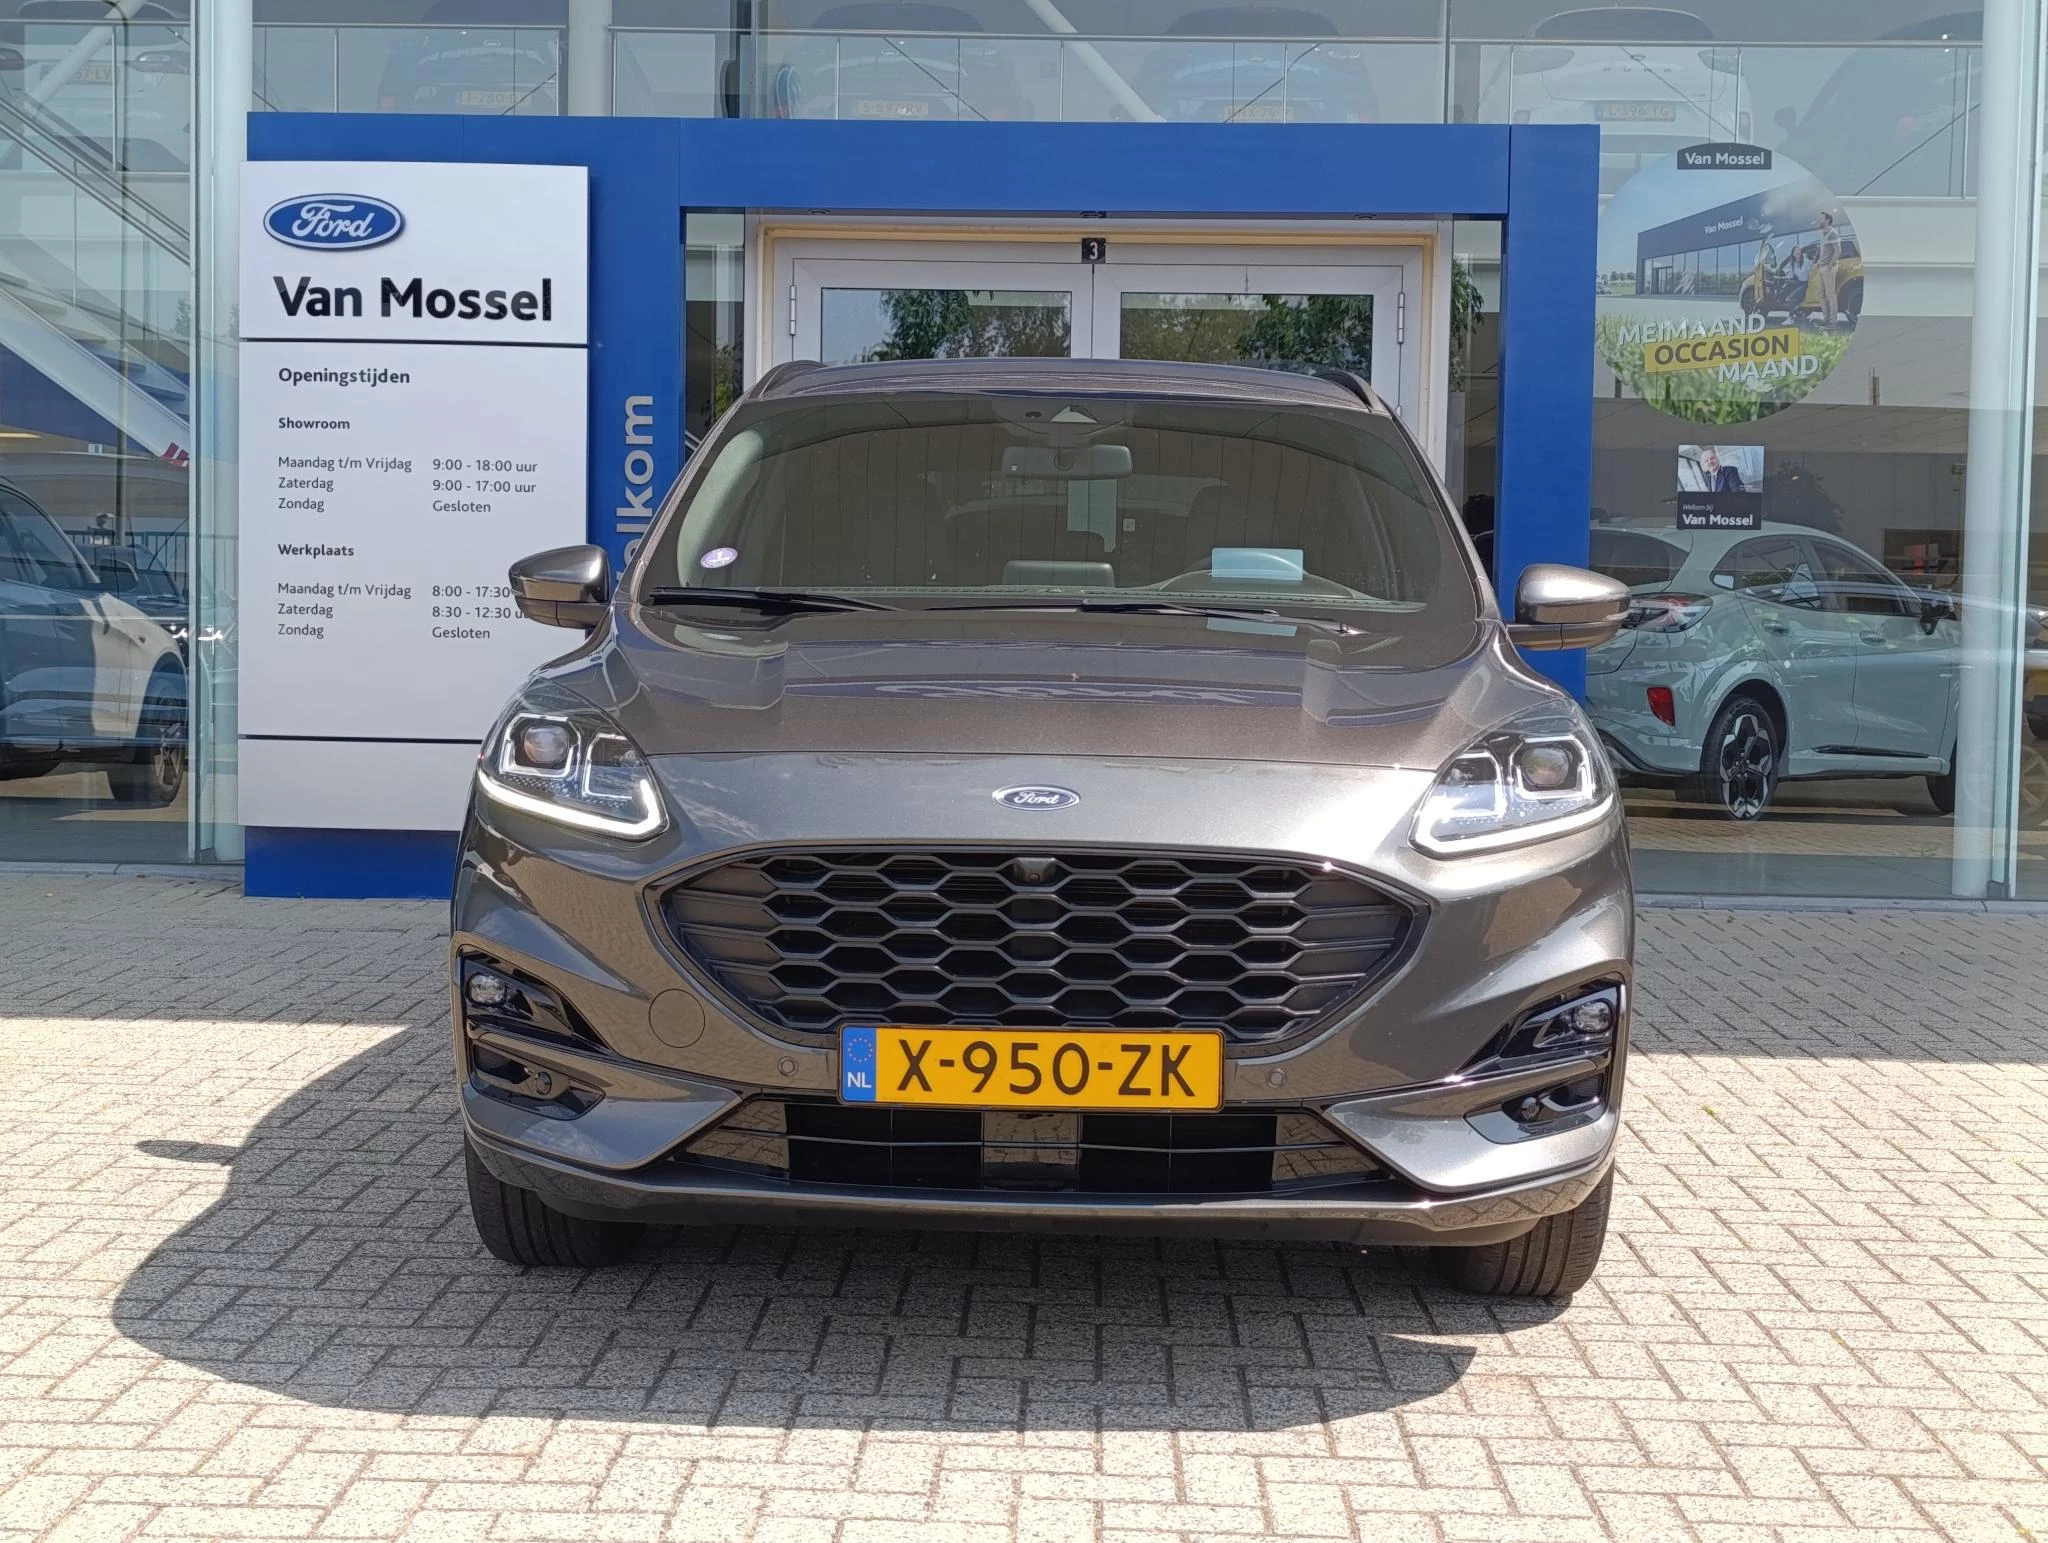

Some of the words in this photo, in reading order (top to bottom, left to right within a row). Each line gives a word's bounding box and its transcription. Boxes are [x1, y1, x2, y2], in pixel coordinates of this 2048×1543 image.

[1684, 152, 1712, 165] Van
[1715, 152, 1765, 165] Mossel
[291, 202, 376, 237] Ford
[1703, 224, 1717, 235] Van
[1718, 216, 1743, 231] Mossel
[1090, 241, 1098, 260] 3
[273, 276, 363, 318] Van
[380, 277, 552, 322] Mossel
[1619, 314, 1766, 346] MEIMAAND
[1654, 334, 1789, 366] OCCASION
[278, 367, 410, 387] Openingstijden
[1718, 355, 1819, 383] MAAND
[278, 416, 351, 430] Showroom
[278, 456, 335, 472] Maandag
[338, 456, 362, 469] t/m
[365, 457, 412, 473] Vrijdag
[432, 459, 463, 471] 9:00
[475, 460, 512, 472] 18:00
[515, 464, 538, 473] uur
[278, 476, 334, 493] Zaterdag
[432, 480, 463, 492] 9:00
[475, 480, 511, 493] 17:00
[514, 484, 537, 493] uur
[278, 497, 325, 513] Zondag
[432, 499, 491, 513] Gesloten
[1682, 514, 1706, 525] Van
[1709, 514, 1753, 525] Mossel
[278, 543, 355, 560] Werkplaats
[277, 582, 335, 599] Maandag
[337, 582, 362, 596] t/m
[365, 583, 412, 600] Vrijdag
[432, 585, 462, 597] 8:00
[475, 586, 510, 598] 17:30
[277, 602, 334, 619] Zaterdag
[432, 606, 462, 618] 8:30
[475, 607, 511, 619] 12:30
[277, 623, 324, 640] Zondag
[432, 626, 491, 640] Gesloten
[1014, 791, 1060, 804] Ford
[847, 1072, 872, 1089] NL
[896, 1039, 1196, 1098] X-950-ZK
